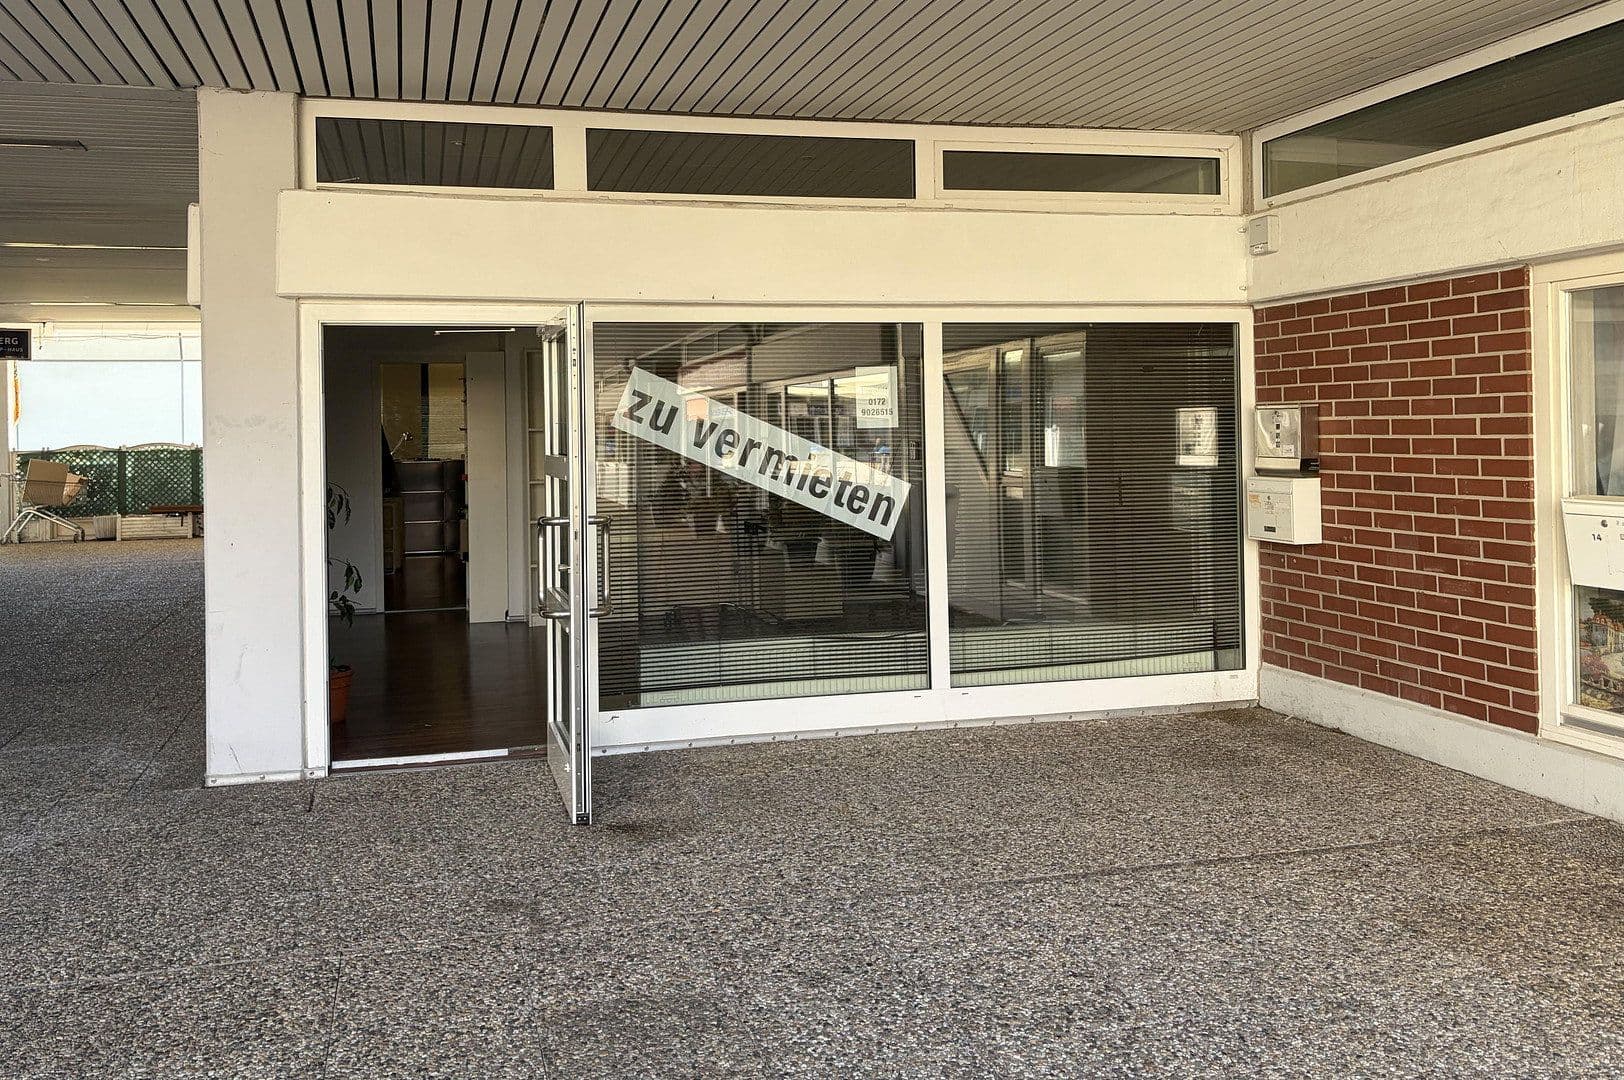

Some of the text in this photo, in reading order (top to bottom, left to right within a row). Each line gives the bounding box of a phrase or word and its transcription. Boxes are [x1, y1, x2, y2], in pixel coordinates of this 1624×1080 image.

[868, 397, 886, 406] 0172
[622, 389, 896, 527] zu vermieten
[1592, 533, 1602, 541] 14
